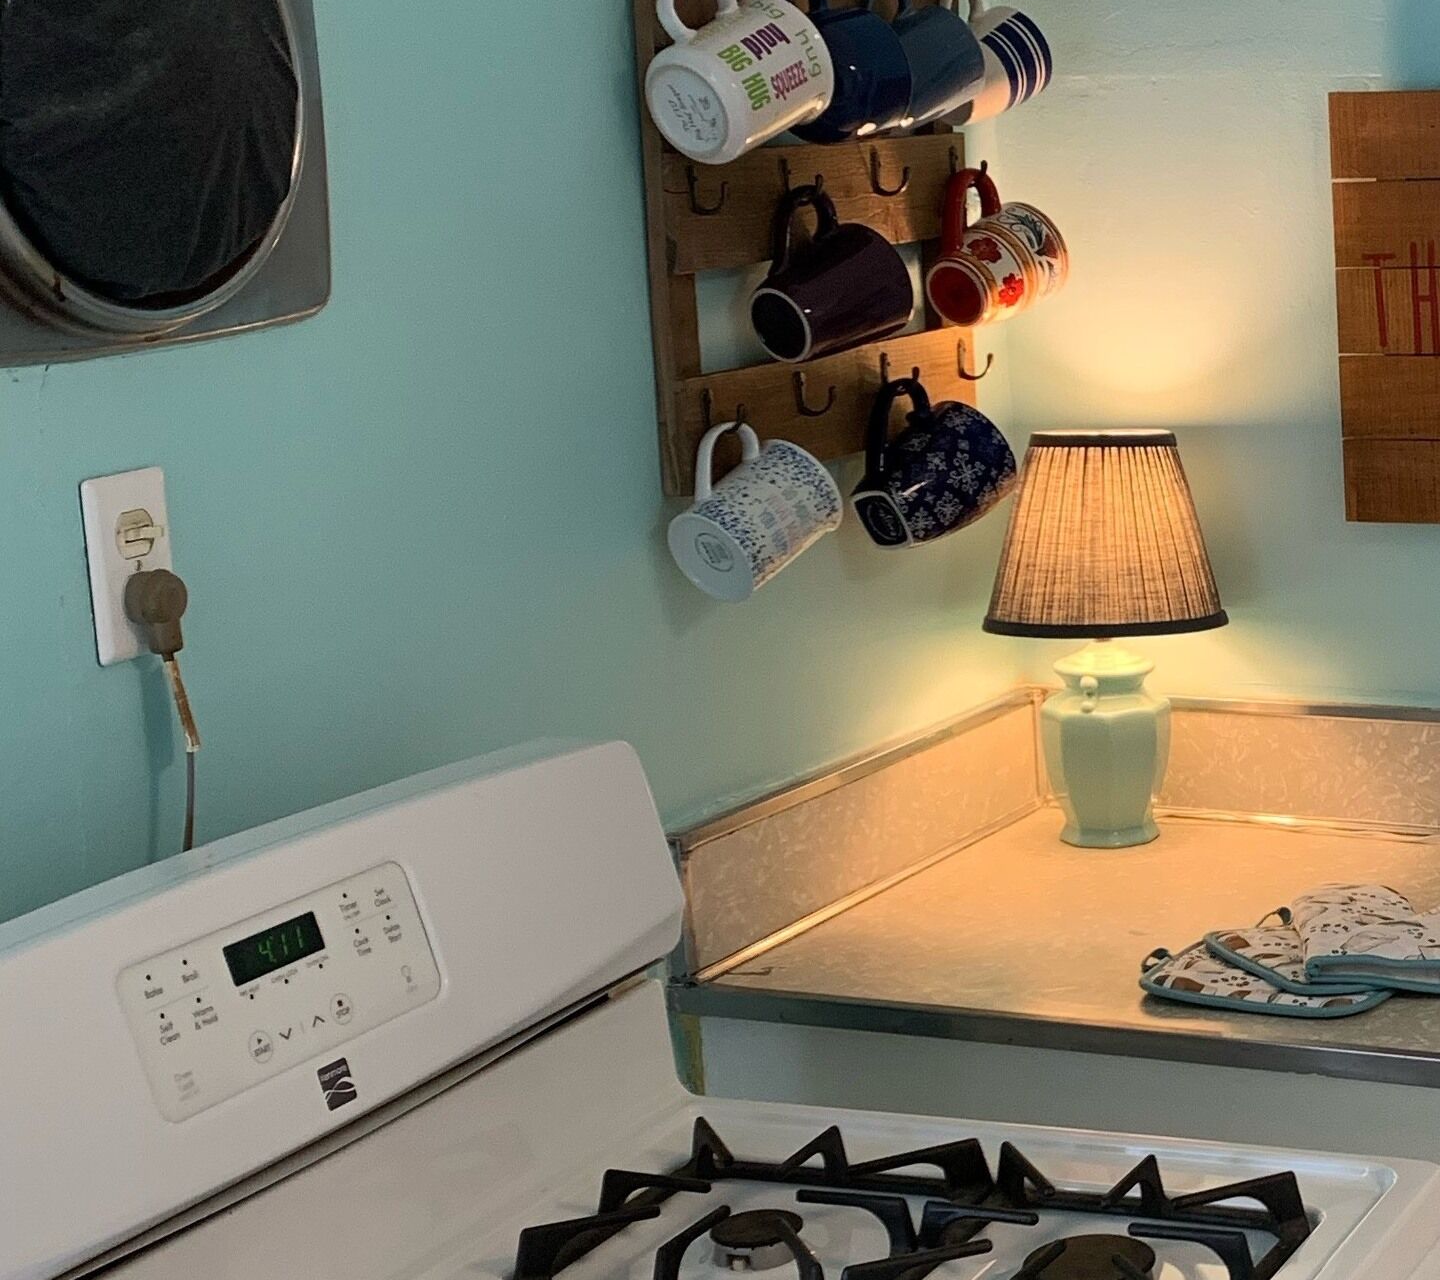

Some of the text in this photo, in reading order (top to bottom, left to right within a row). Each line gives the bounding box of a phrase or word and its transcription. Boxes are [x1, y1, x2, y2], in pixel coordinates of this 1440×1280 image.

[717, 43, 753, 72] BIG
[741, 71, 771, 111] HUG
[794, 28, 822, 78] hug
[770, 60, 808, 101] SQUEEZE
